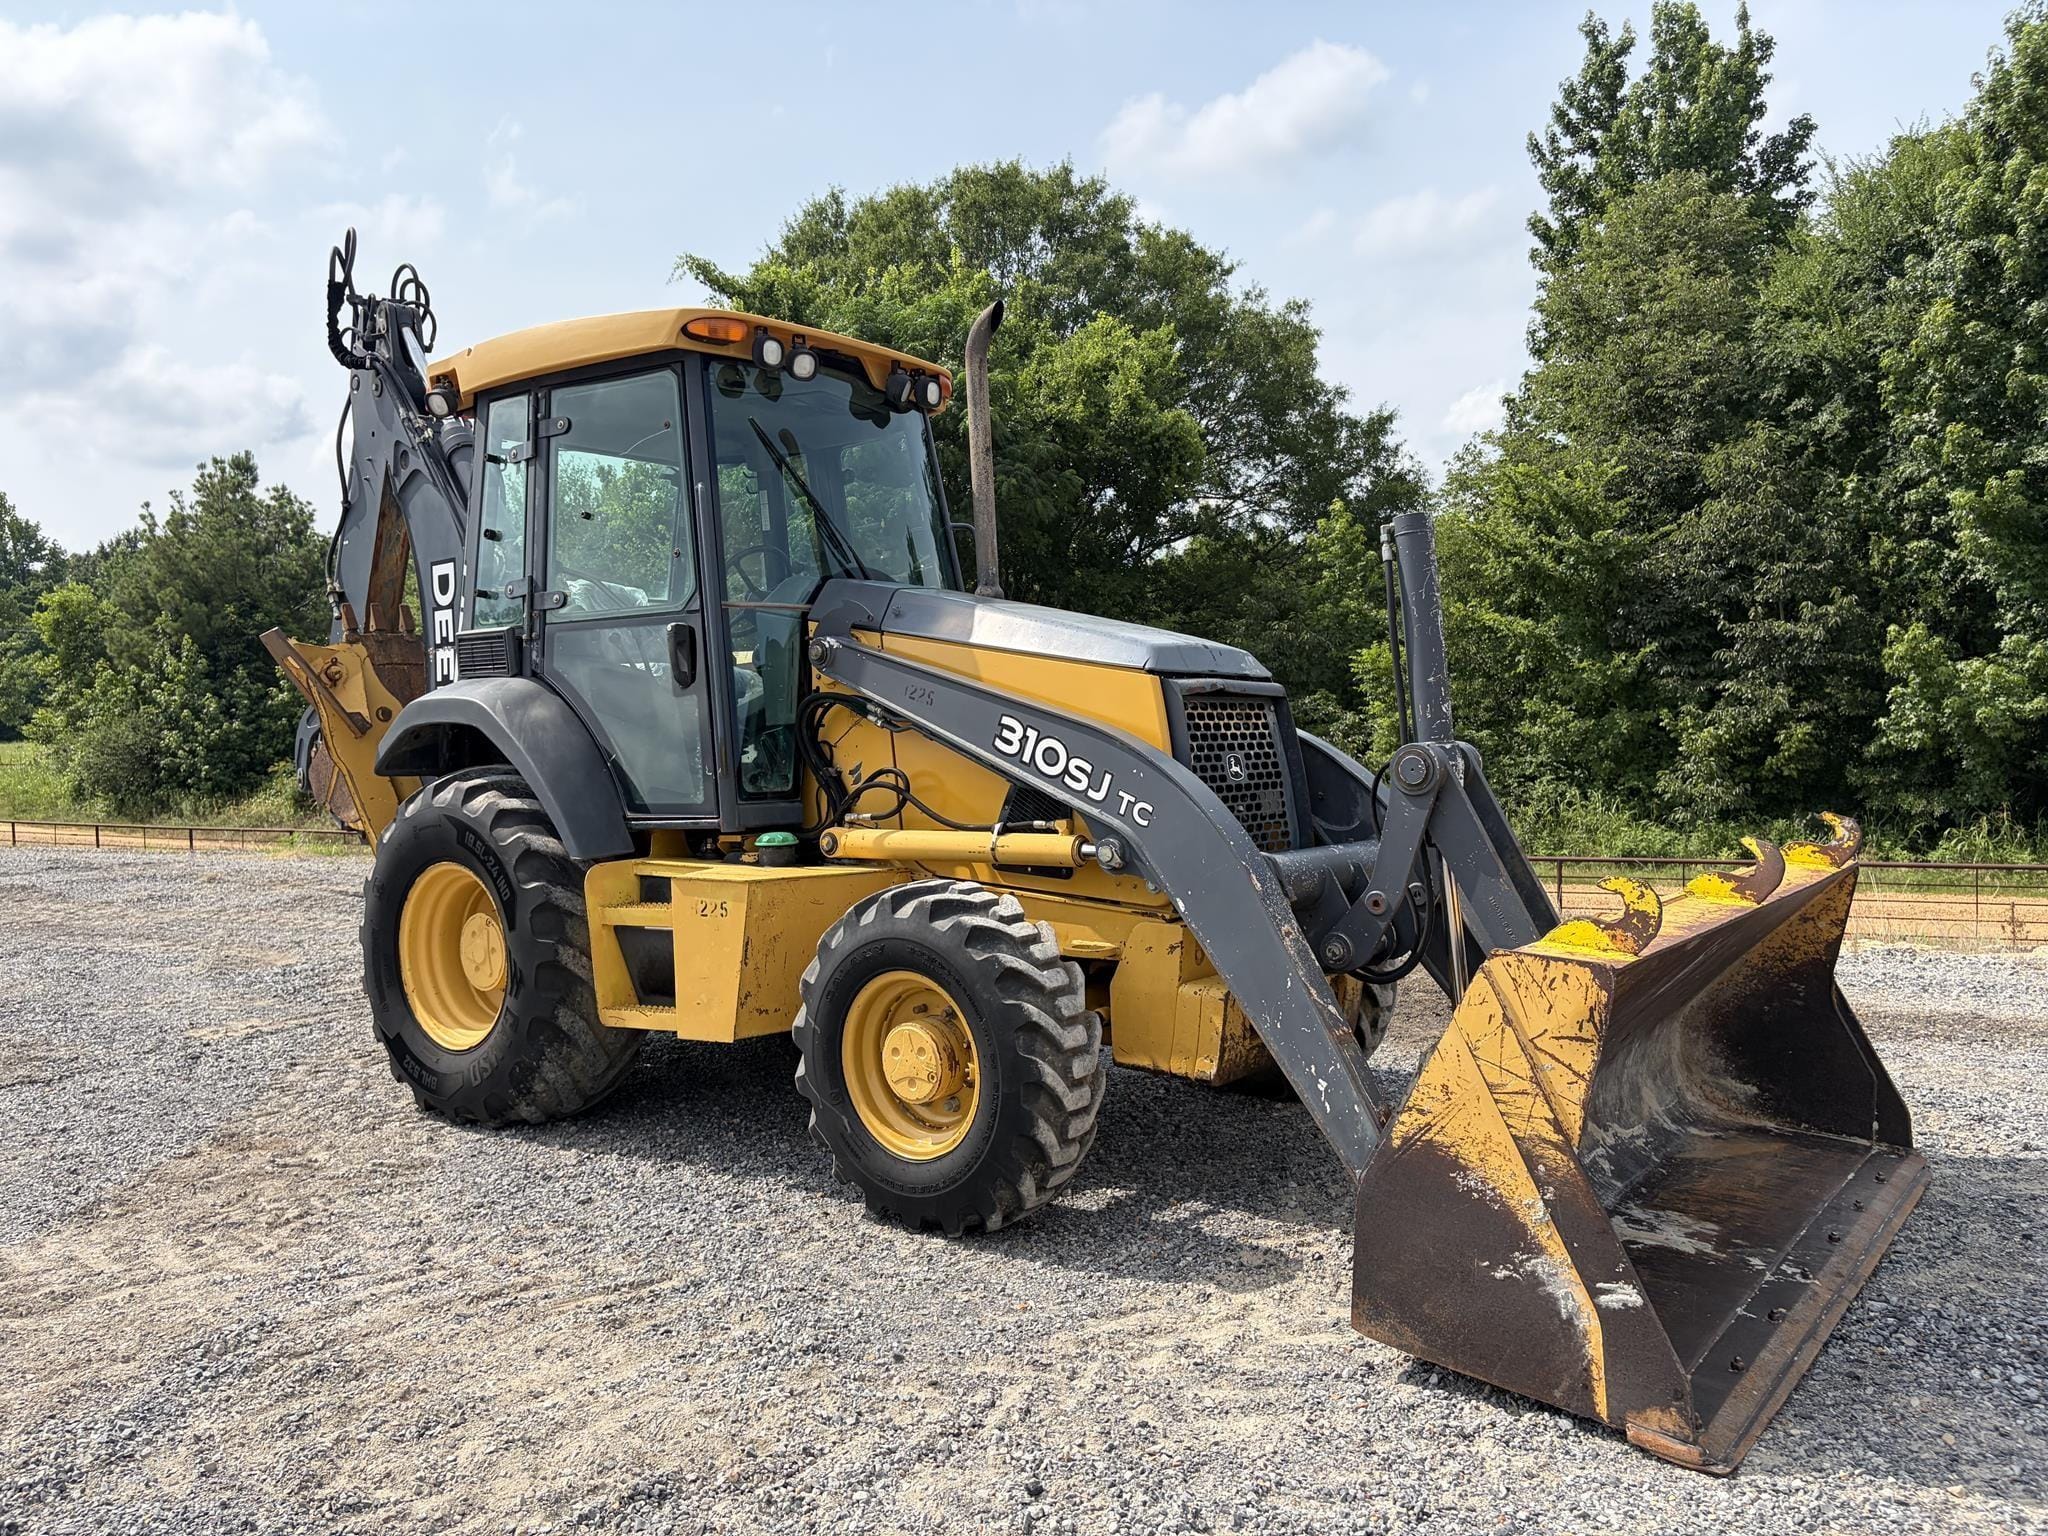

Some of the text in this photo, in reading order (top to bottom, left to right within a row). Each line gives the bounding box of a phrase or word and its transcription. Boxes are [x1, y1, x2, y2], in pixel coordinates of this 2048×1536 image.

[431, 560, 456, 690] DEE
[993, 714, 1155, 828] 310SJ TC
[496, 875, 511, 901] IND
